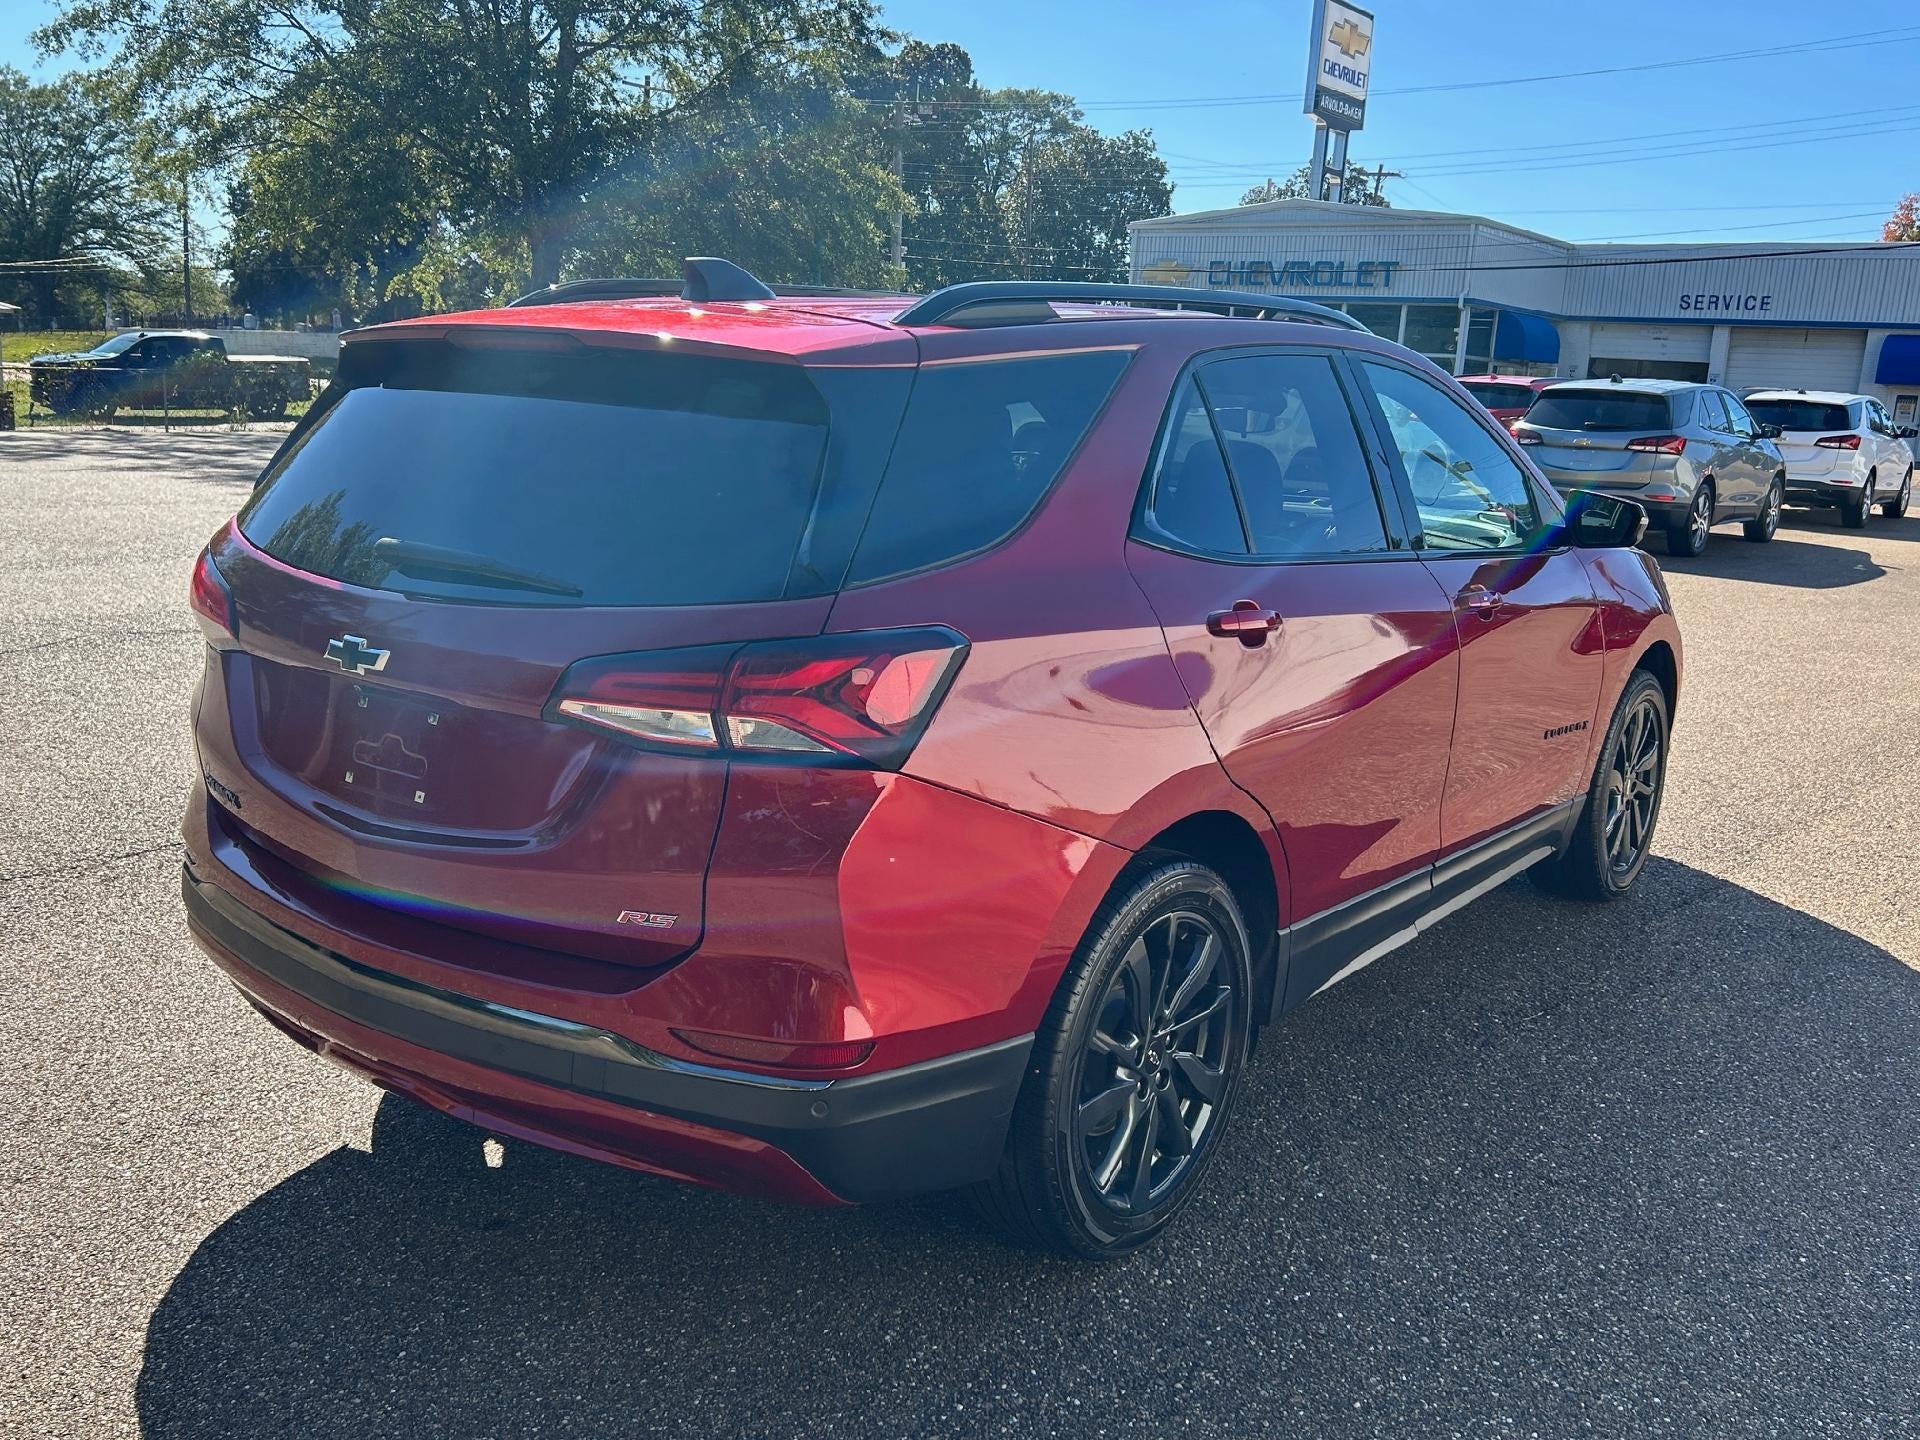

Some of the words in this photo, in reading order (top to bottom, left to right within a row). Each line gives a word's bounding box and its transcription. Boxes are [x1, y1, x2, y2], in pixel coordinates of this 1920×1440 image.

[1323, 58, 1368, 89] CHEVROLET
[1320, 95, 1362, 121] ARNOLD-BAKER
[1208, 260, 1399, 288] CHEVROLET
[1680, 294, 1772, 311] SERVICE
[617, 910, 679, 929] RS
